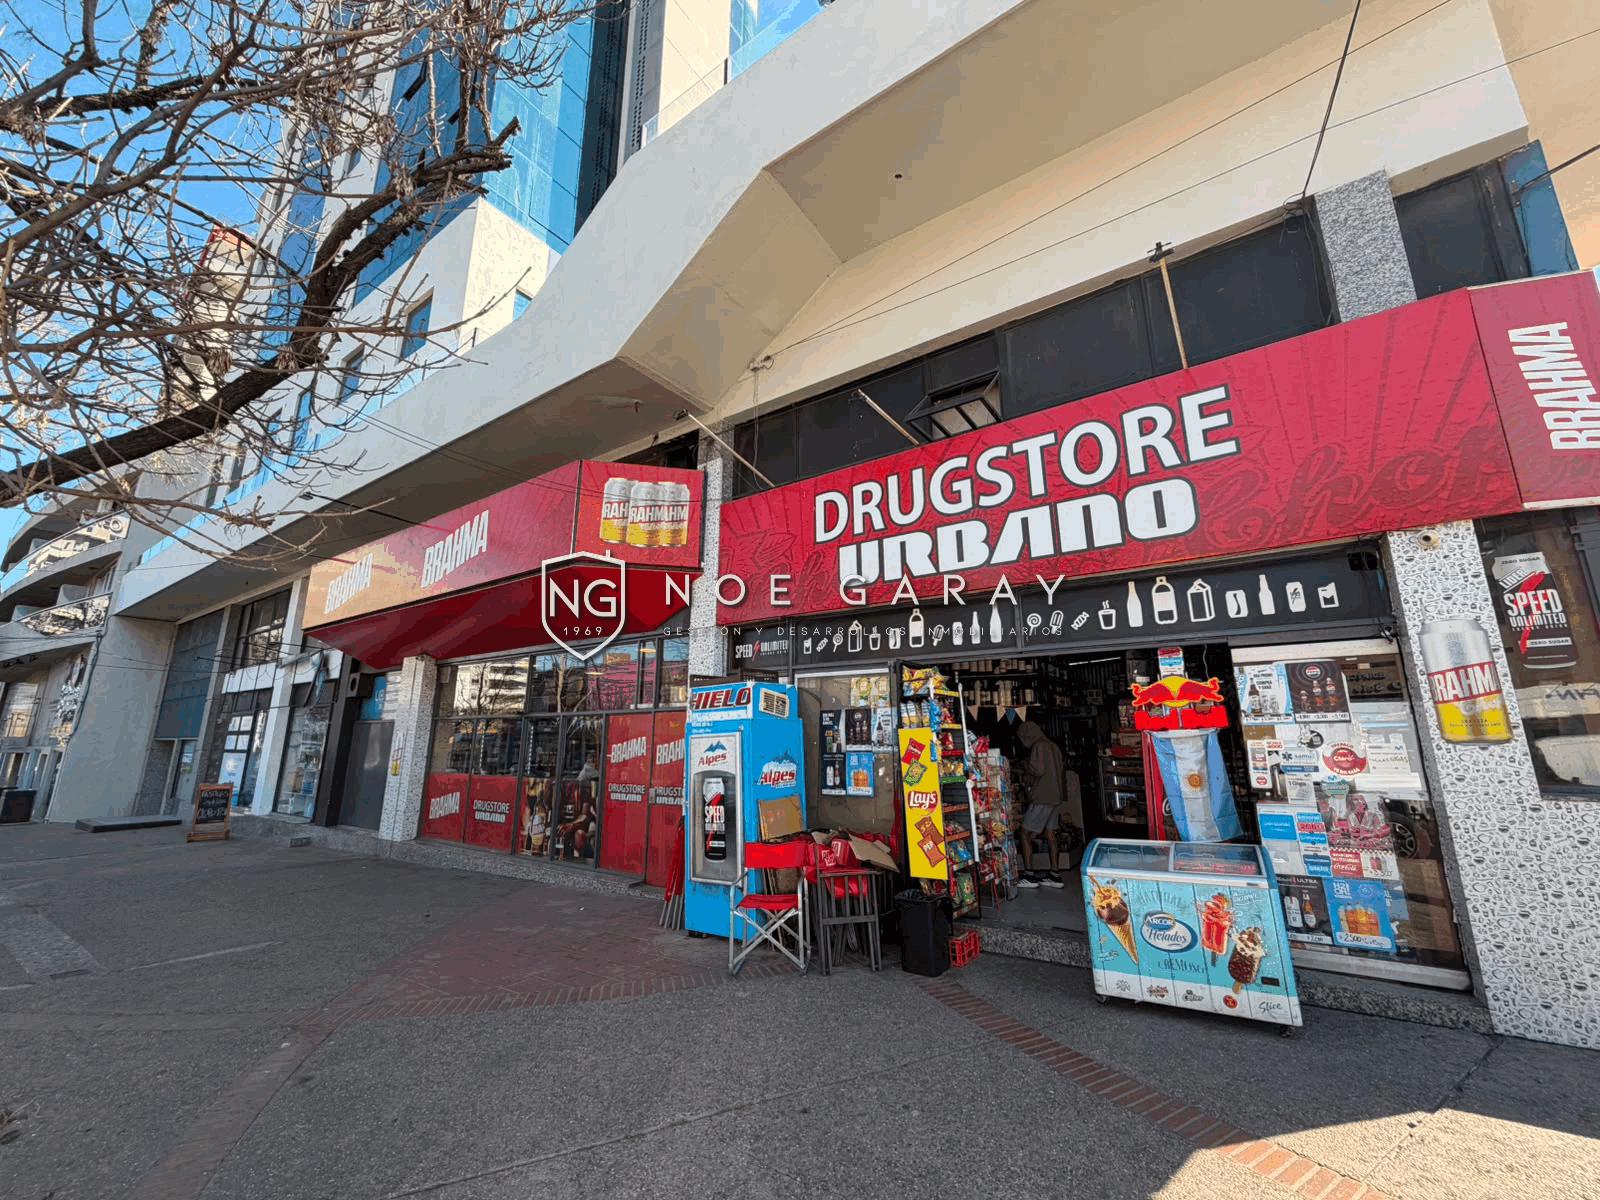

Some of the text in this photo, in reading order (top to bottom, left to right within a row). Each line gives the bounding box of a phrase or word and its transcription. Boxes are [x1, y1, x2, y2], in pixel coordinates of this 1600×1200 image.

[1507, 321, 1600, 450] BRAHMA
[814, 384, 1241, 544] DRUGSTORE
[836, 477, 1198, 587] URBANO
[421, 509, 490, 589] BRAHMA
[324, 552, 374, 615] BRAHMA
[1499, 568, 1528, 590] LIDER
[1503, 588, 1563, 617] SPEED
[1509, 612, 1567, 628] UNLIMITED
[735, 643, 753, 659] SPEED
[690, 687, 751, 710] HIELO
[610, 736, 647, 764] BRAHMA
[697, 752, 727, 768] Alpes
[759, 768, 796, 787] Alpes
[608, 782, 646, 794] DRUGSTORE
[428, 791, 460, 820] BRAHMA
[473, 799, 510, 814] DRUGSTORE
[704, 805, 726, 824] SPEED
[1144, 914, 1175, 927] ARCOR
[1147, 928, 1188, 944] Helados
[1258, 1001, 1283, 1012] Slice
